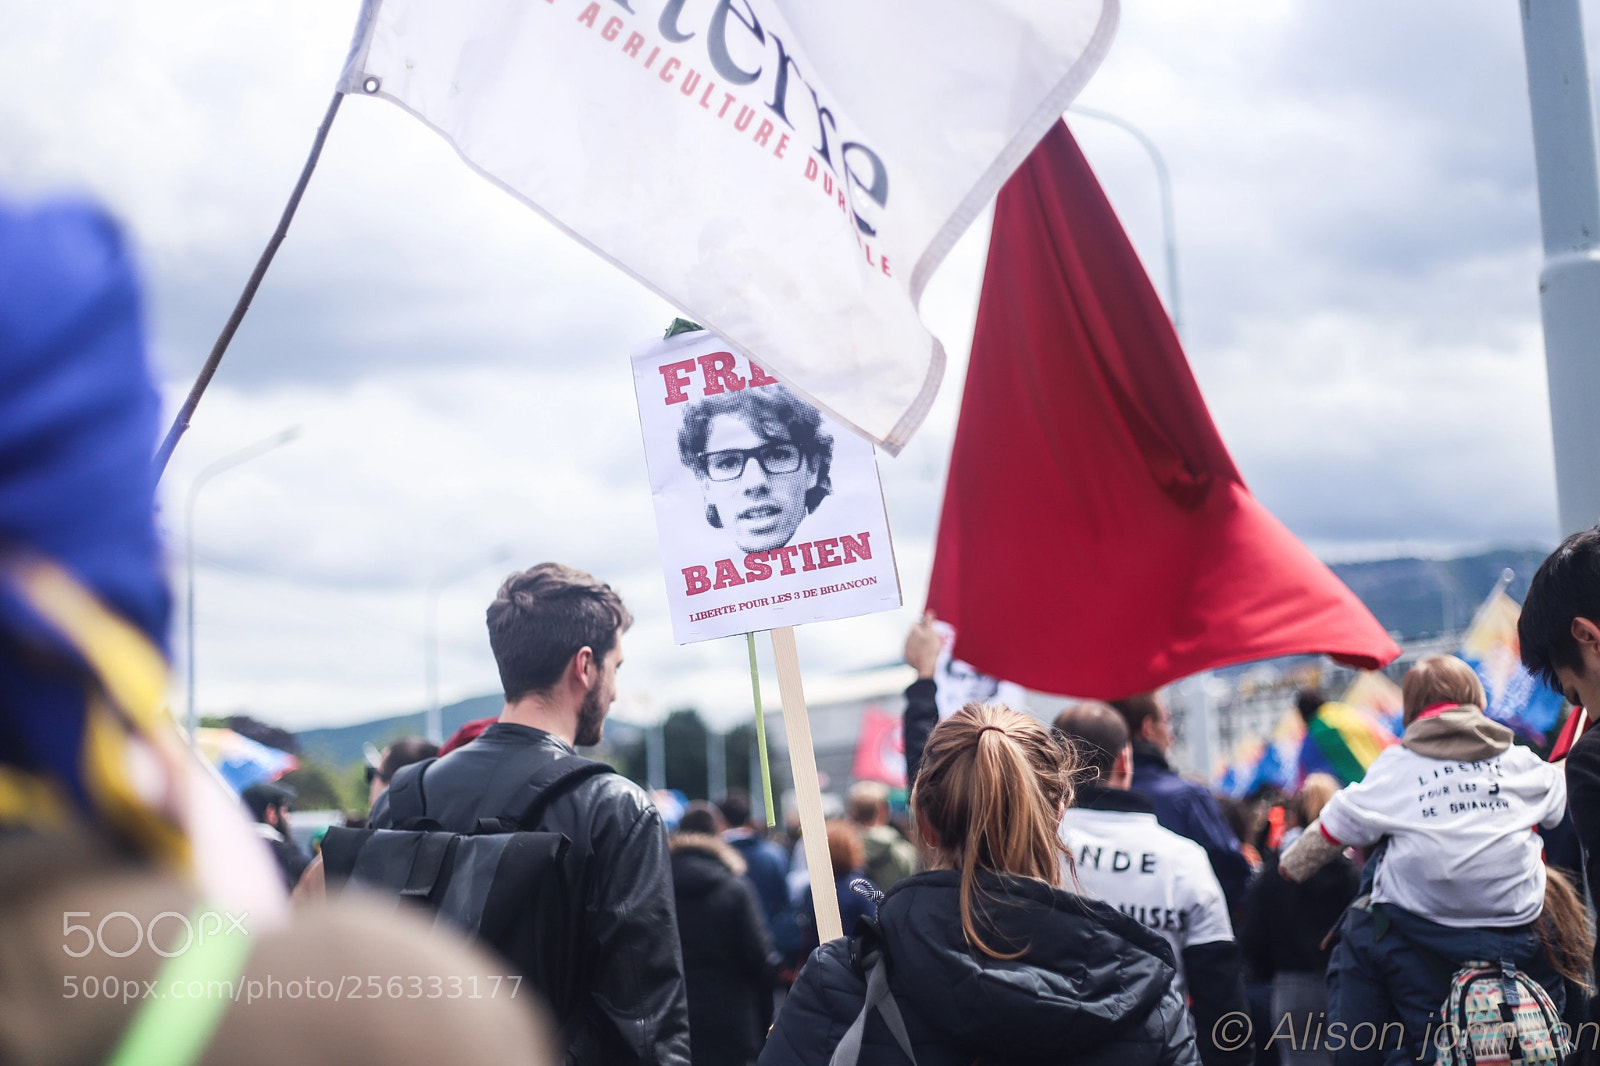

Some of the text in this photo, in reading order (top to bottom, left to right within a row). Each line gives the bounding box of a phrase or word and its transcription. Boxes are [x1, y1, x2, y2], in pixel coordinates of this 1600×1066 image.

[577, 1, 790, 160] AGRICULTURE
[681, 531, 873, 596] BASTIEN
[689, 576, 878, 623] LIBERTE POUR LES 3 DE BRIANCON
[1422, 806, 1438, 818] DE
[1078, 845, 1156, 874] NDE
